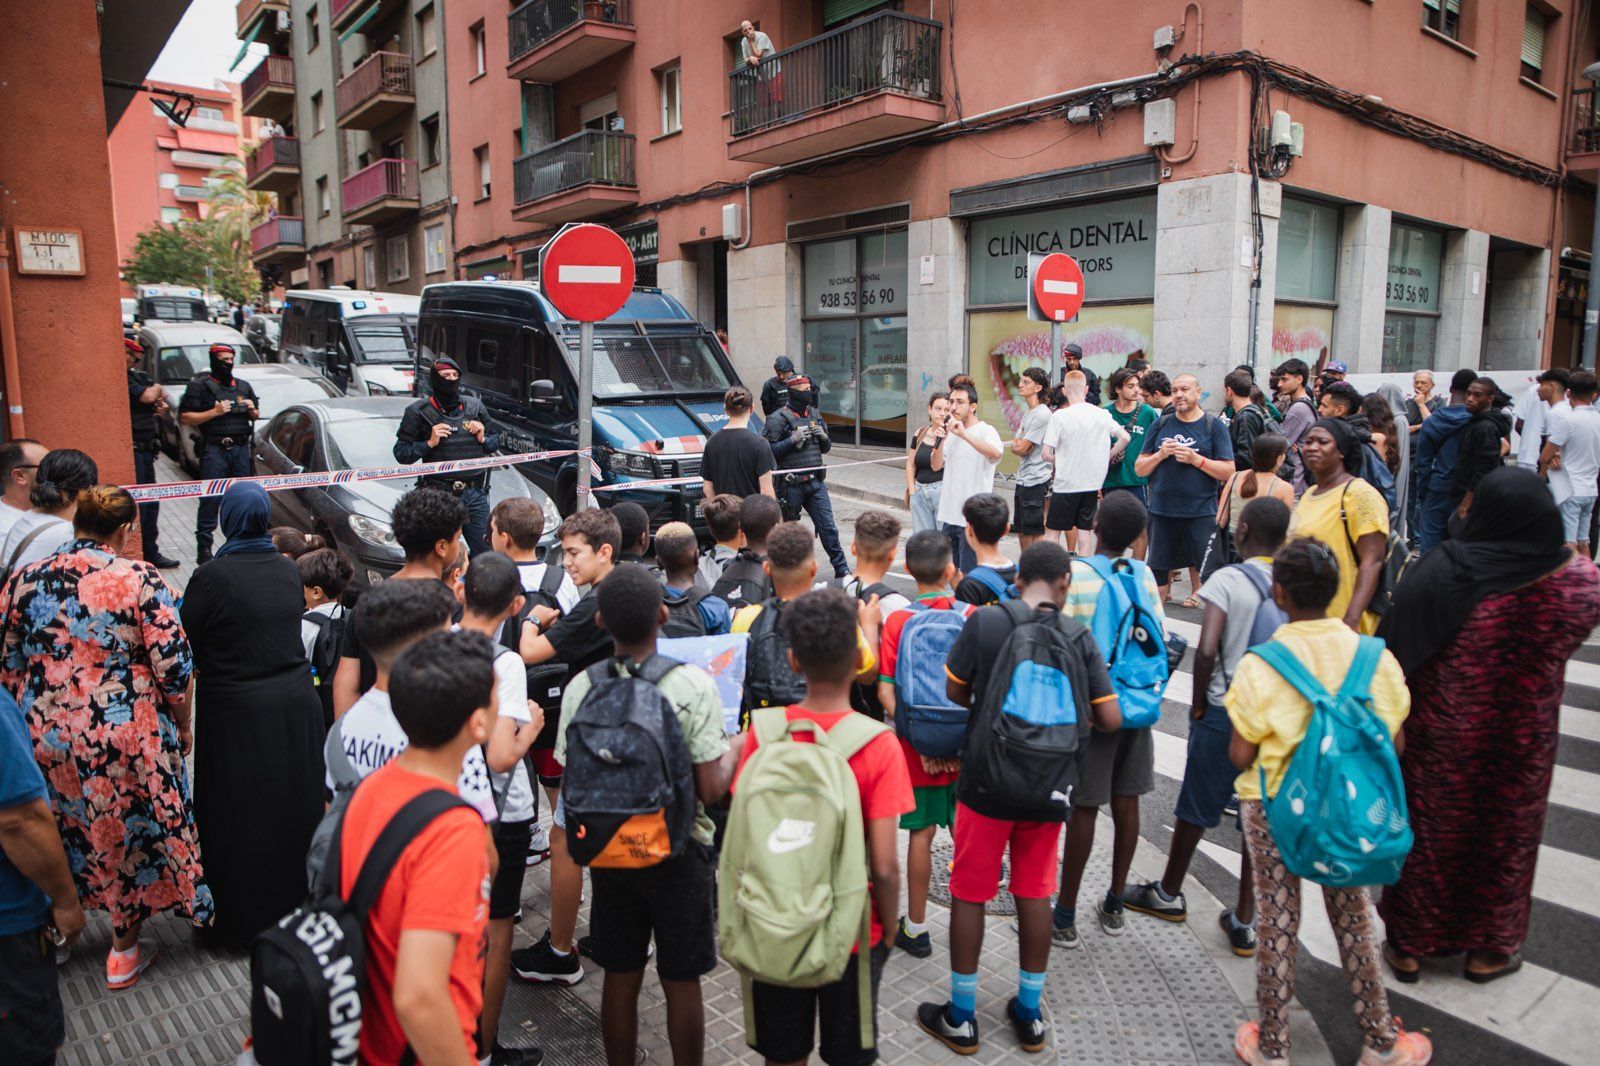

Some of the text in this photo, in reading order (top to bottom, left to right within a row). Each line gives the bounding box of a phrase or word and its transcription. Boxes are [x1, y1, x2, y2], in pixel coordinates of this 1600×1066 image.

[988, 219, 1148, 257] CLÍNICA DENTAL
[820, 288, 894, 308] 938 53 56 90
[1393, 283, 1404, 301] 53
[1406, 285, 1416, 303] 56
[1418, 286, 1429, 303] 90
